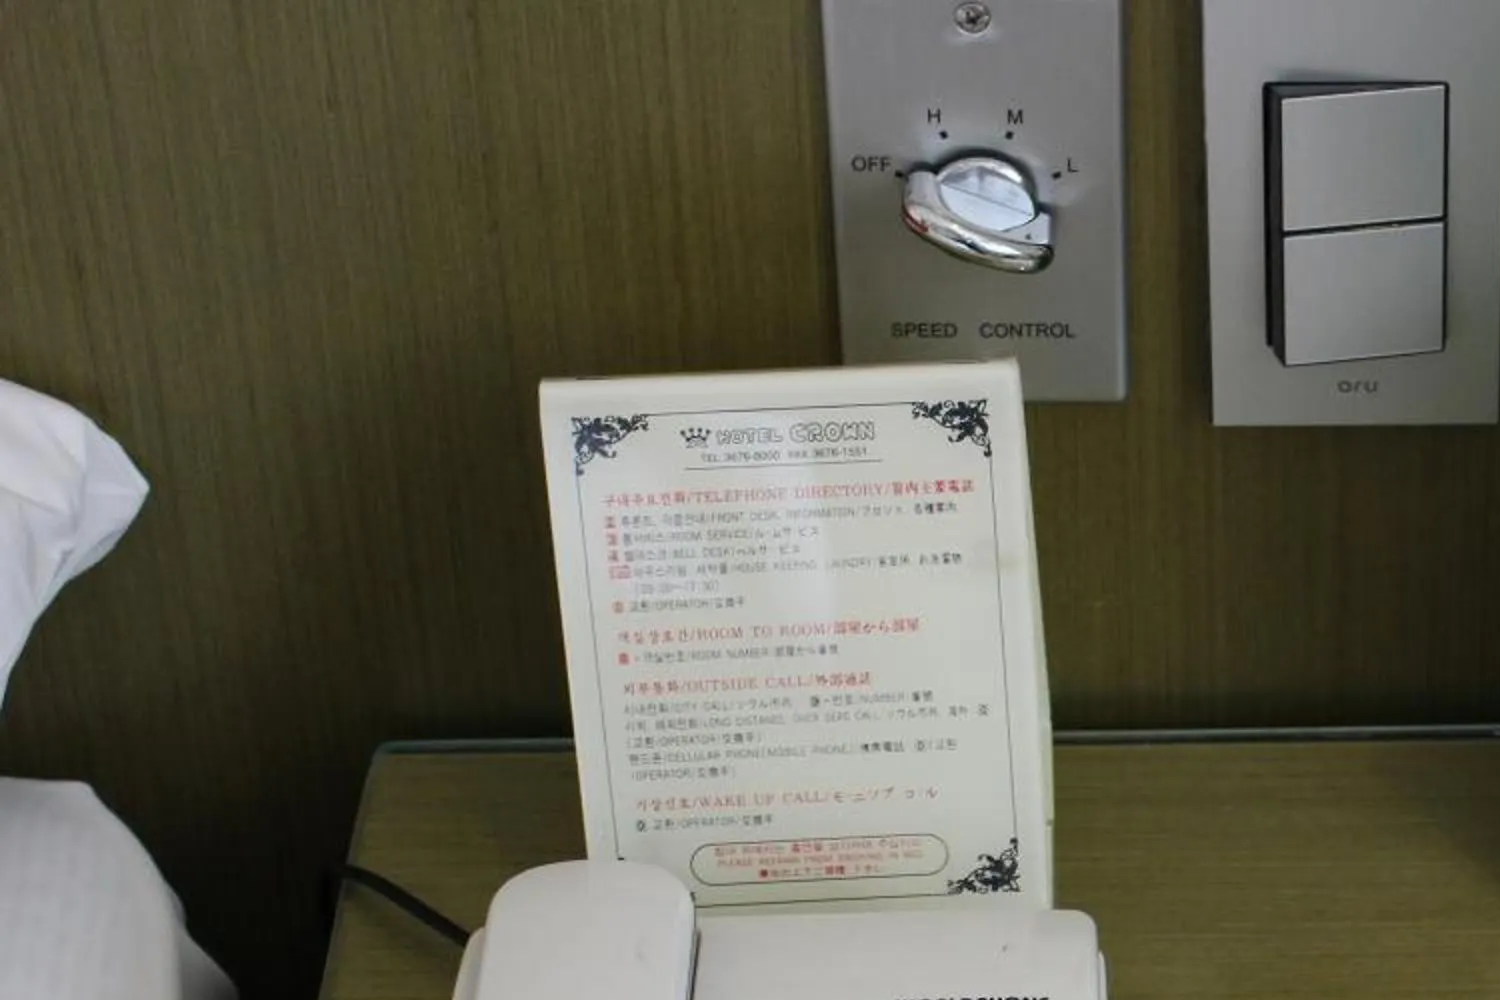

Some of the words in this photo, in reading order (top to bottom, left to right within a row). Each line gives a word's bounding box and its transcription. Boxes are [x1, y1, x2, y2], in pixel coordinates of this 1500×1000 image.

[928, 109, 942, 124] H
[1007, 109, 1023, 125] M
[851, 156, 891, 172] OFF
[1067, 157, 1079, 173] L
[891, 322, 958, 339] SPEED
[978, 322, 1075, 339] CONTROL
[715, 427, 783, 446] HOTEL
[789, 421, 875, 443] CROWN
